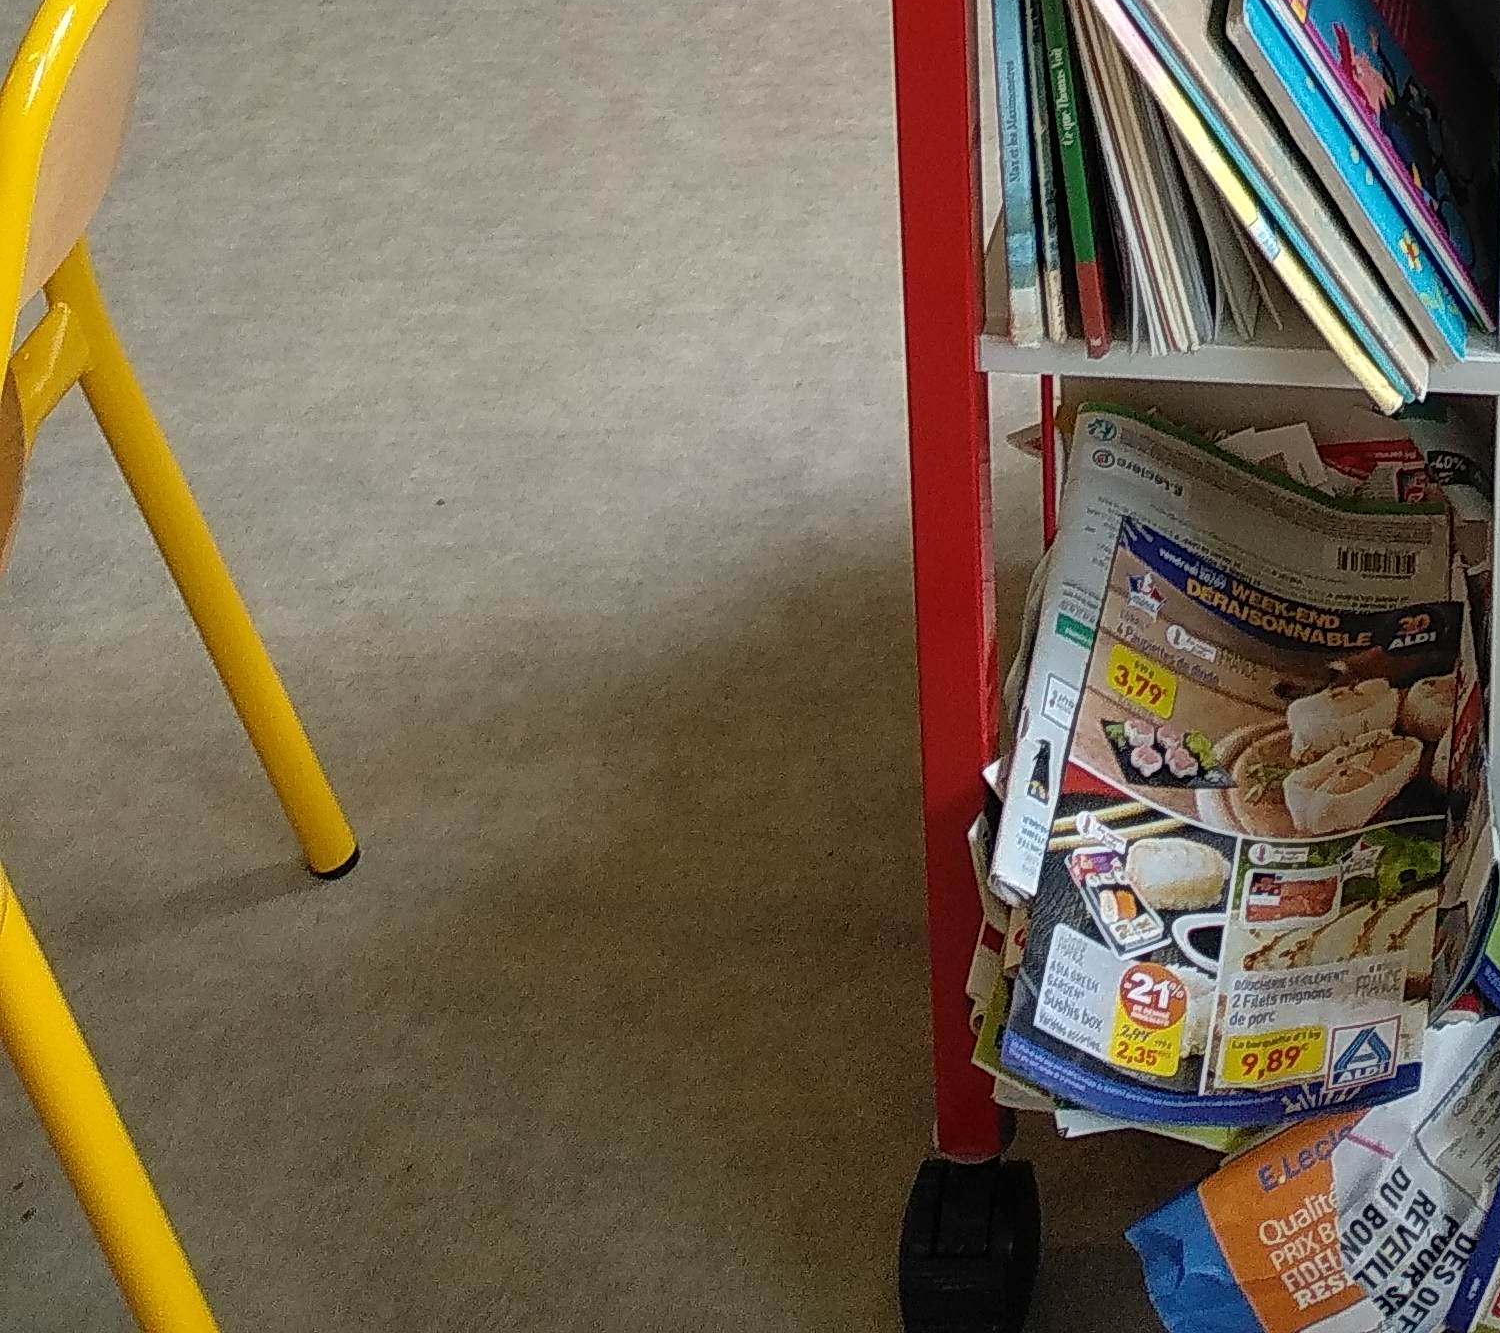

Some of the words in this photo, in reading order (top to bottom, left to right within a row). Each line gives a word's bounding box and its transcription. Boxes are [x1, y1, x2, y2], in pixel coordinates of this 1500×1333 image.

[1002, 60, 1018, 130] Maximonstres
[1006, 132, 1017, 146] les
[1009, 148, 1018, 158] et
[1008, 159, 1020, 182] Max
[1385, 632, 1438, 652] ALDI
[1231, 994, 1241, 1009] 2
[1242, 991, 1278, 1009] Filets
[1279, 986, 1334, 1005] mignons
[1229, 1011, 1246, 1027] de
[1247, 1009, 1277, 1028] porc
[1380, 1165, 1412, 1210] DU
[1269, 1230, 1321, 1271] PRIX
[1401, 1213, 1461, 1287] POUR
[1433, 1232, 1477, 1285] DES
[1373, 1285, 1410, 1317] SE
